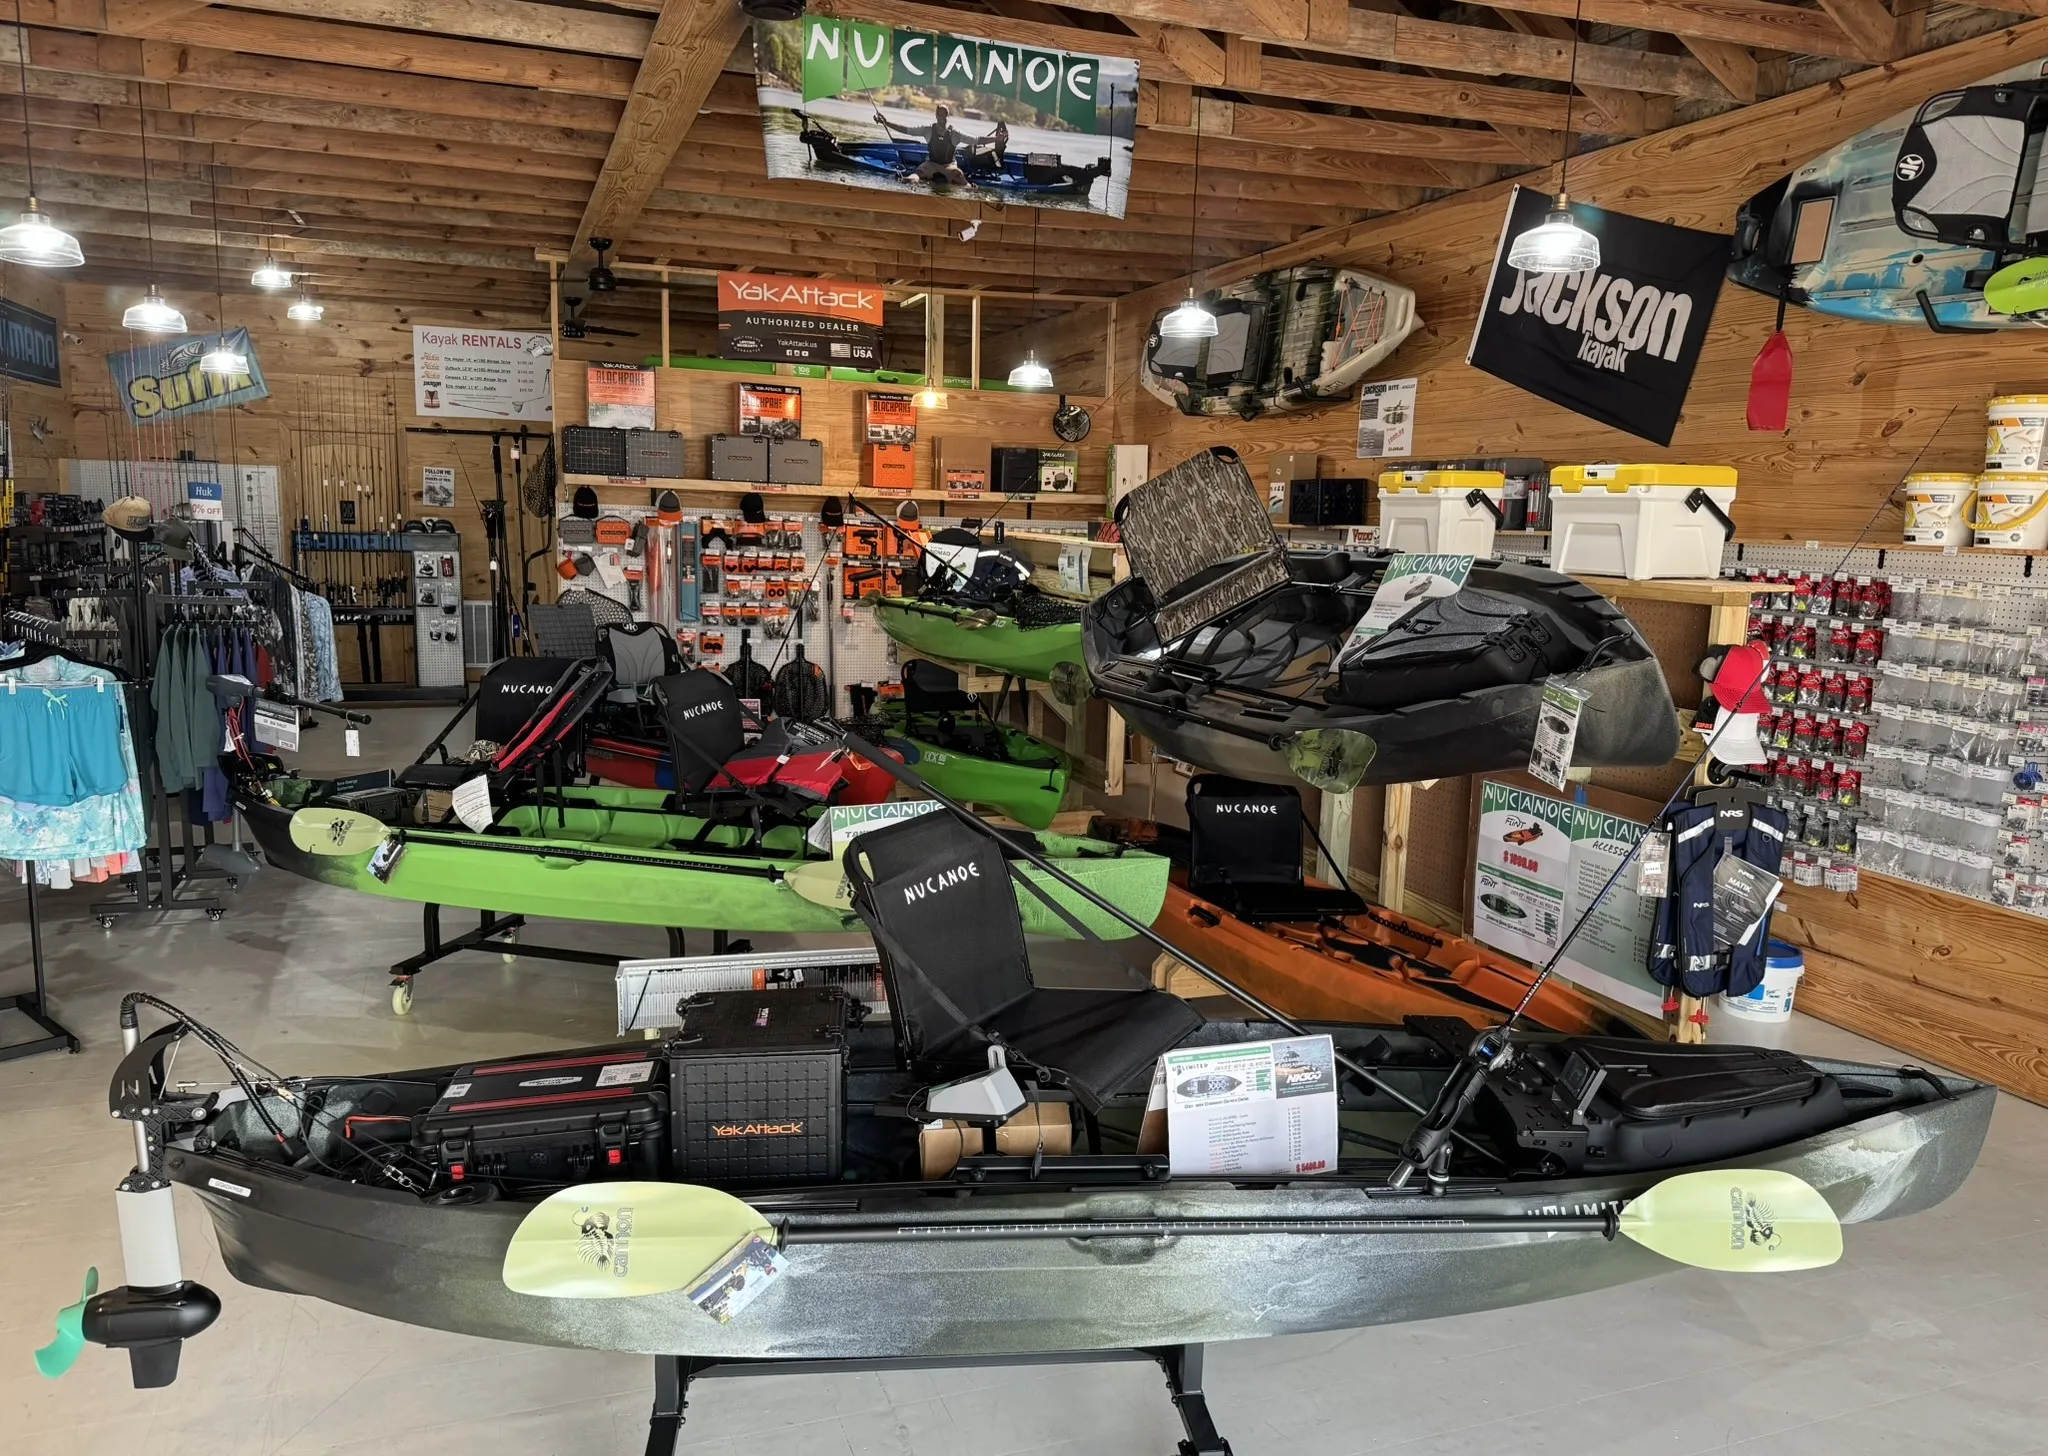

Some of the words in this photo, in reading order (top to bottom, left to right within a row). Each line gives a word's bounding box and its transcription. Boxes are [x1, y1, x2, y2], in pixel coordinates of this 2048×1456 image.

[806, 21, 1094, 101] NUCANOE
[728, 280, 874, 310] YakAttack
[745, 316, 815, 329] AUTHORIZED
[819, 321, 860, 332] DEALER
[421, 332, 459, 347] Kayak
[462, 334, 523, 350] RENTALS
[777, 338, 818, 349] YakAttack.us
[853, 350, 873, 359] USA
[1576, 330, 1629, 373] kayak
[196, 486, 213, 497] Huk
[1389, 556, 1470, 573] NUCANOE
[683, 700, 724, 721] NUCANOE
[1216, 803, 1278, 815] NUCANOE
[1484, 785, 1572, 824] NUCANOE
[1720, 809, 1744, 818] NRS
[1573, 813, 1647, 843] NUCAN
[903, 861, 980, 905] NUCANOE
[1728, 877, 1752, 893] MATIK
[711, 1121, 804, 1137] YakAttack
[1295, 1164, 1300, 1173] $
[1731, 1187, 1744, 1250] cannon
[613, 1207, 634, 1277] cannon
